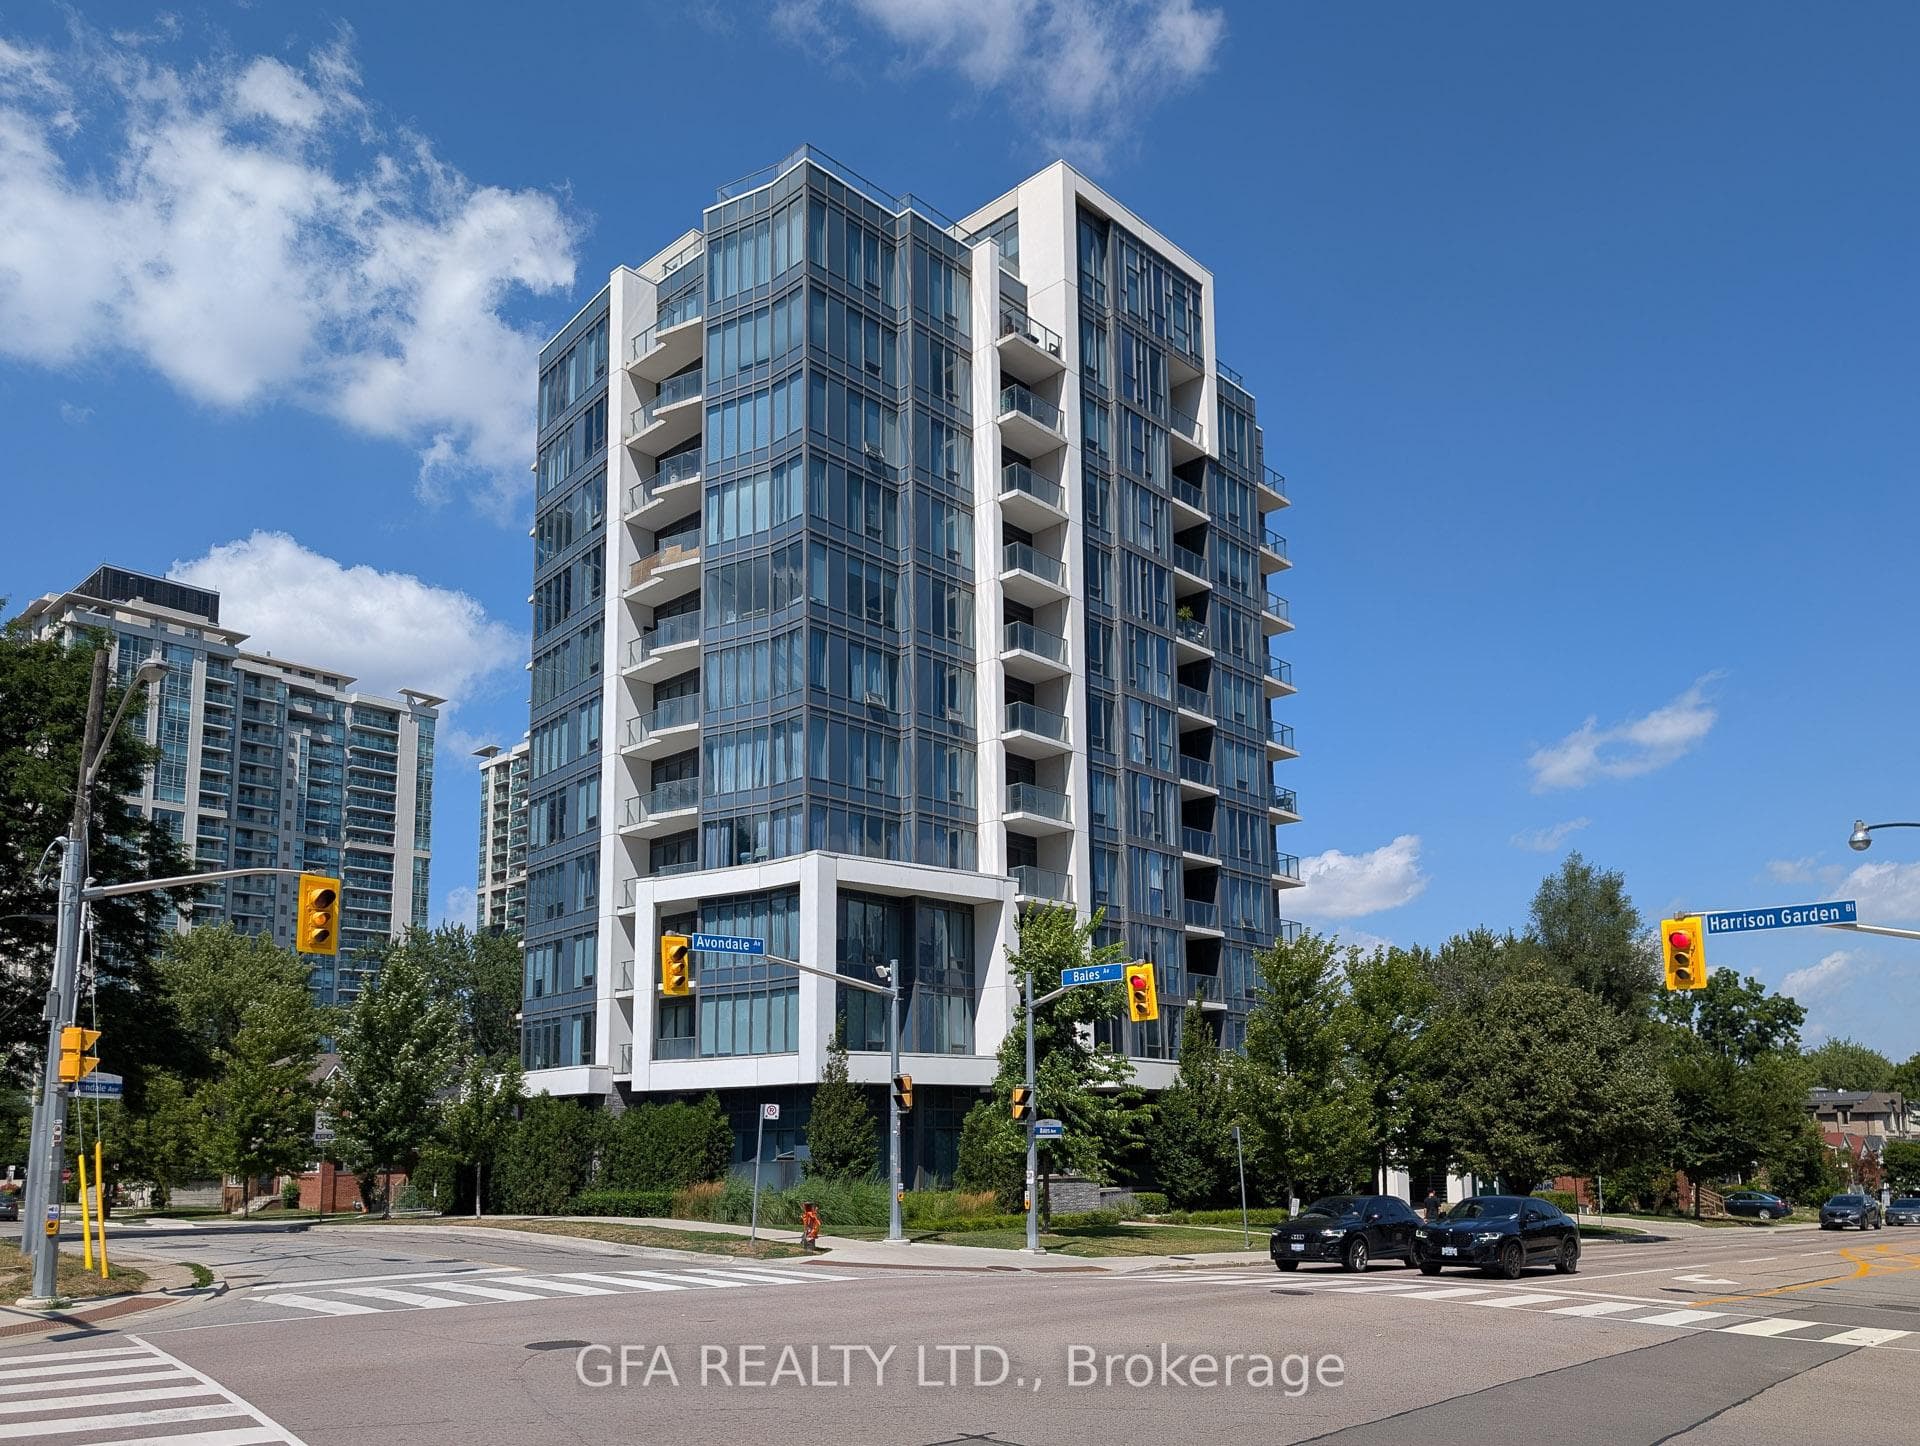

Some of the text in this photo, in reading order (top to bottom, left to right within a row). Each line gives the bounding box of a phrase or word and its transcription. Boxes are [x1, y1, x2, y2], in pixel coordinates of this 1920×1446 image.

[1710, 914, 1775, 931] Harrison
[1781, 908, 1840, 924] Garden
[696, 936, 750, 951] Avondale
[1073, 970, 1100, 982] Bales
[71, 1084, 107, 1092] Aondale
